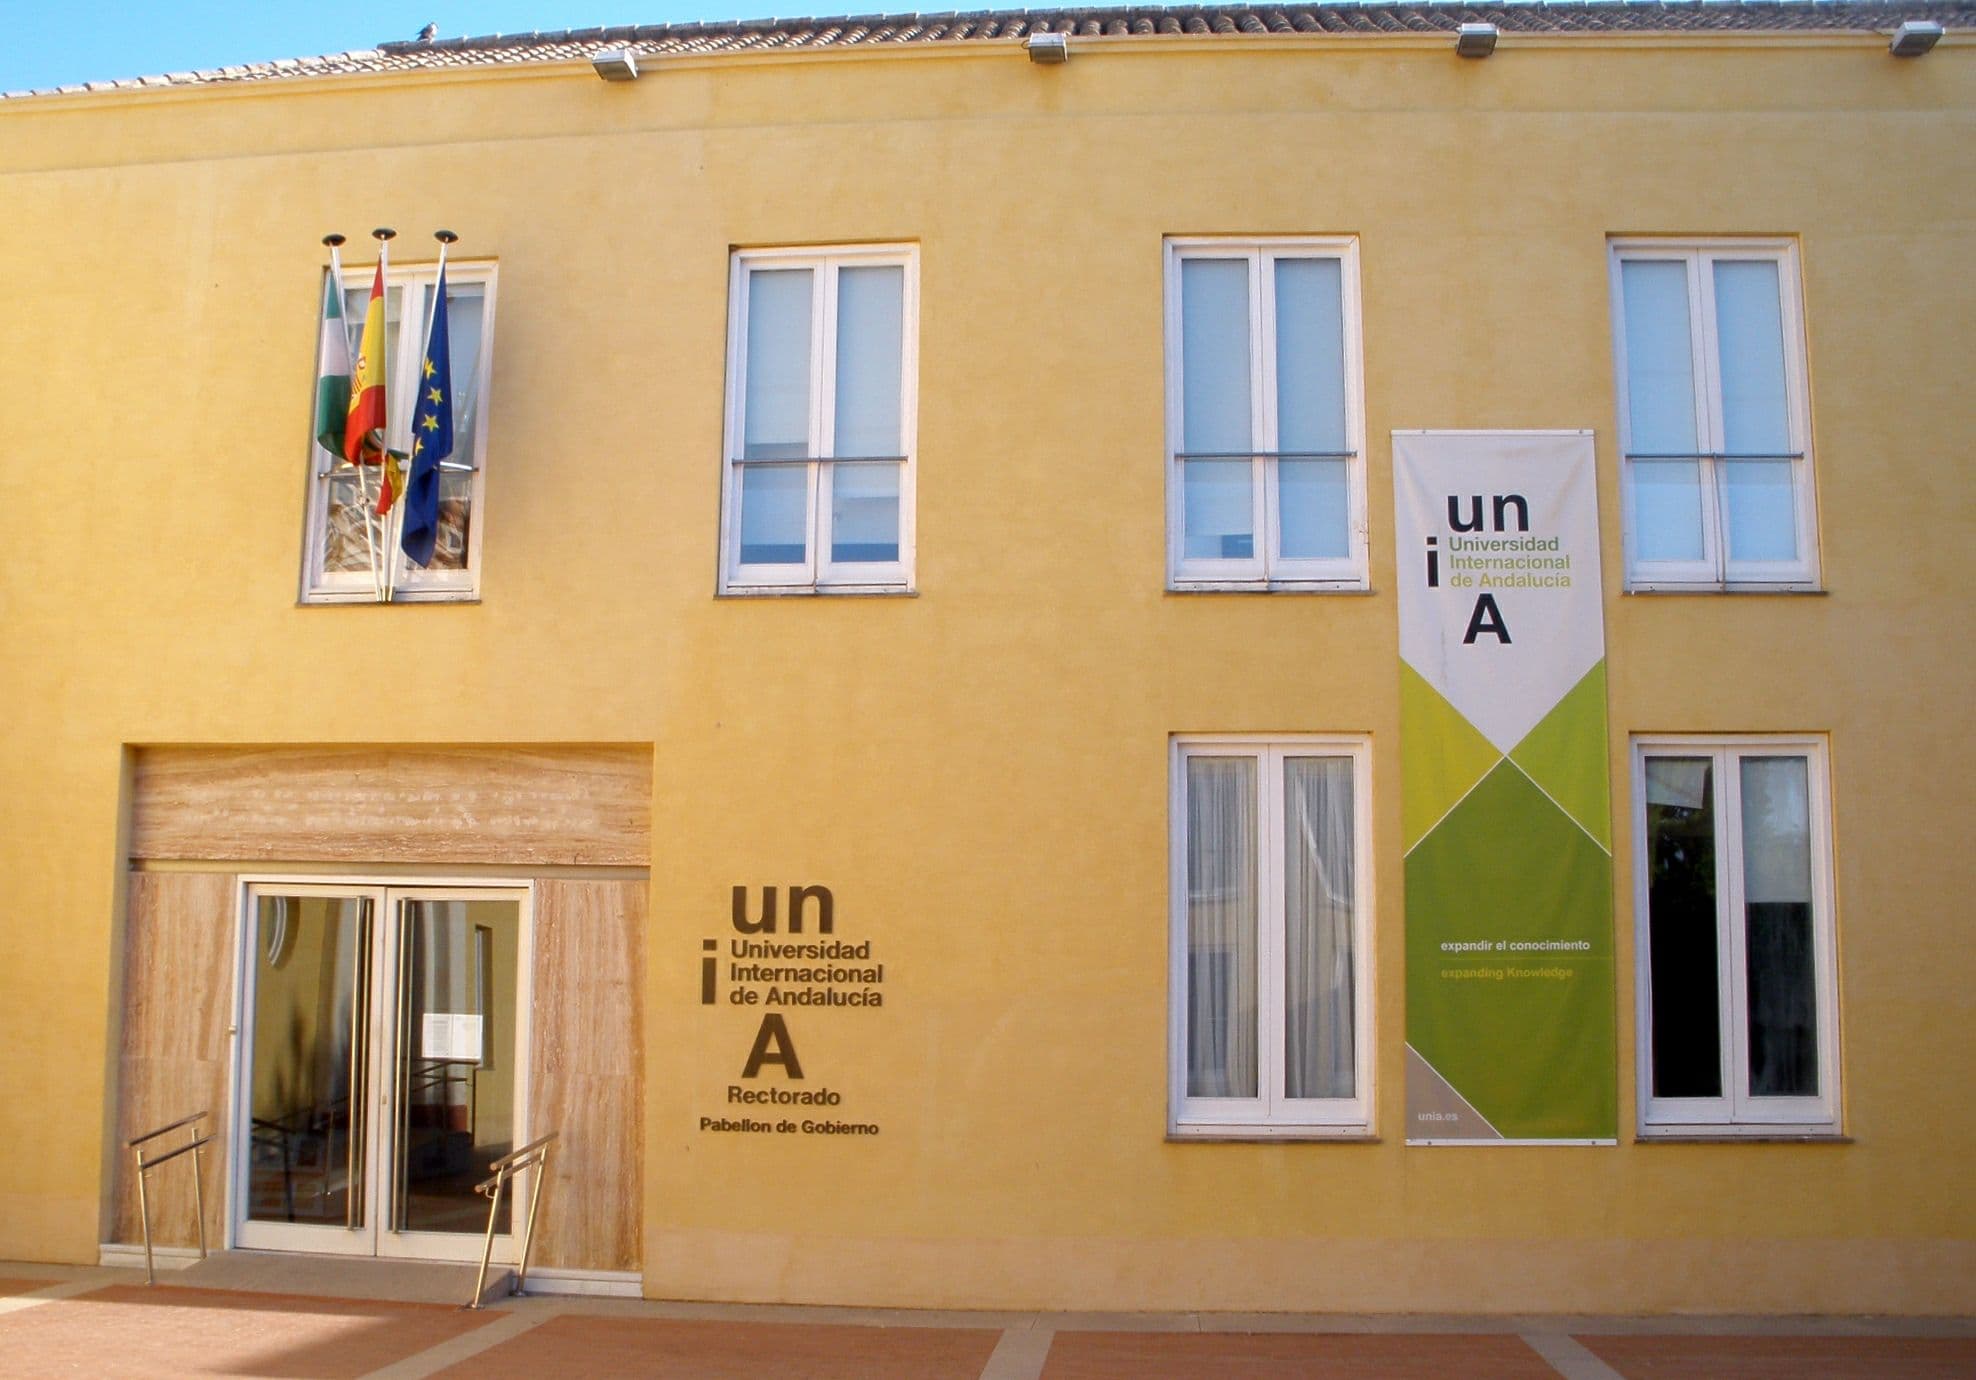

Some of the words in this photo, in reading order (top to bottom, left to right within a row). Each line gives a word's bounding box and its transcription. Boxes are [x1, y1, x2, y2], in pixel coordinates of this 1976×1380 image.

[1447, 494, 1529, 532] un
[1449, 537, 1559, 552] Universidad
[1426, 536, 1439, 587] i
[1450, 554, 1570, 569] Internacional
[1450, 573, 1473, 588] de
[1479, 572, 1572, 588] Andalucía
[1462, 592, 1513, 645] A
[732, 884, 834, 934] un
[731, 939, 870, 959] Universidad
[1440, 940, 1493, 953] expandir
[1496, 940, 1507, 951] el
[1509, 940, 1591, 951] conocimiento
[701, 938, 717, 1005] i
[730, 963, 883, 983] Internacional
[1440, 967, 1504, 980] expanding
[1507, 967, 1574, 979] Knowledge
[729, 986, 759, 1005] de
[765, 986, 883, 1007] Andalucía
[741, 1012, 805, 1080] A
[728, 1085, 841, 1106] Rectorado
[700, 1117, 772, 1133] Pabellon
[776, 1120, 797, 1133] de
[801, 1120, 879, 1135] Gobierno
[1418, 1111, 1459, 1121] unia.es
